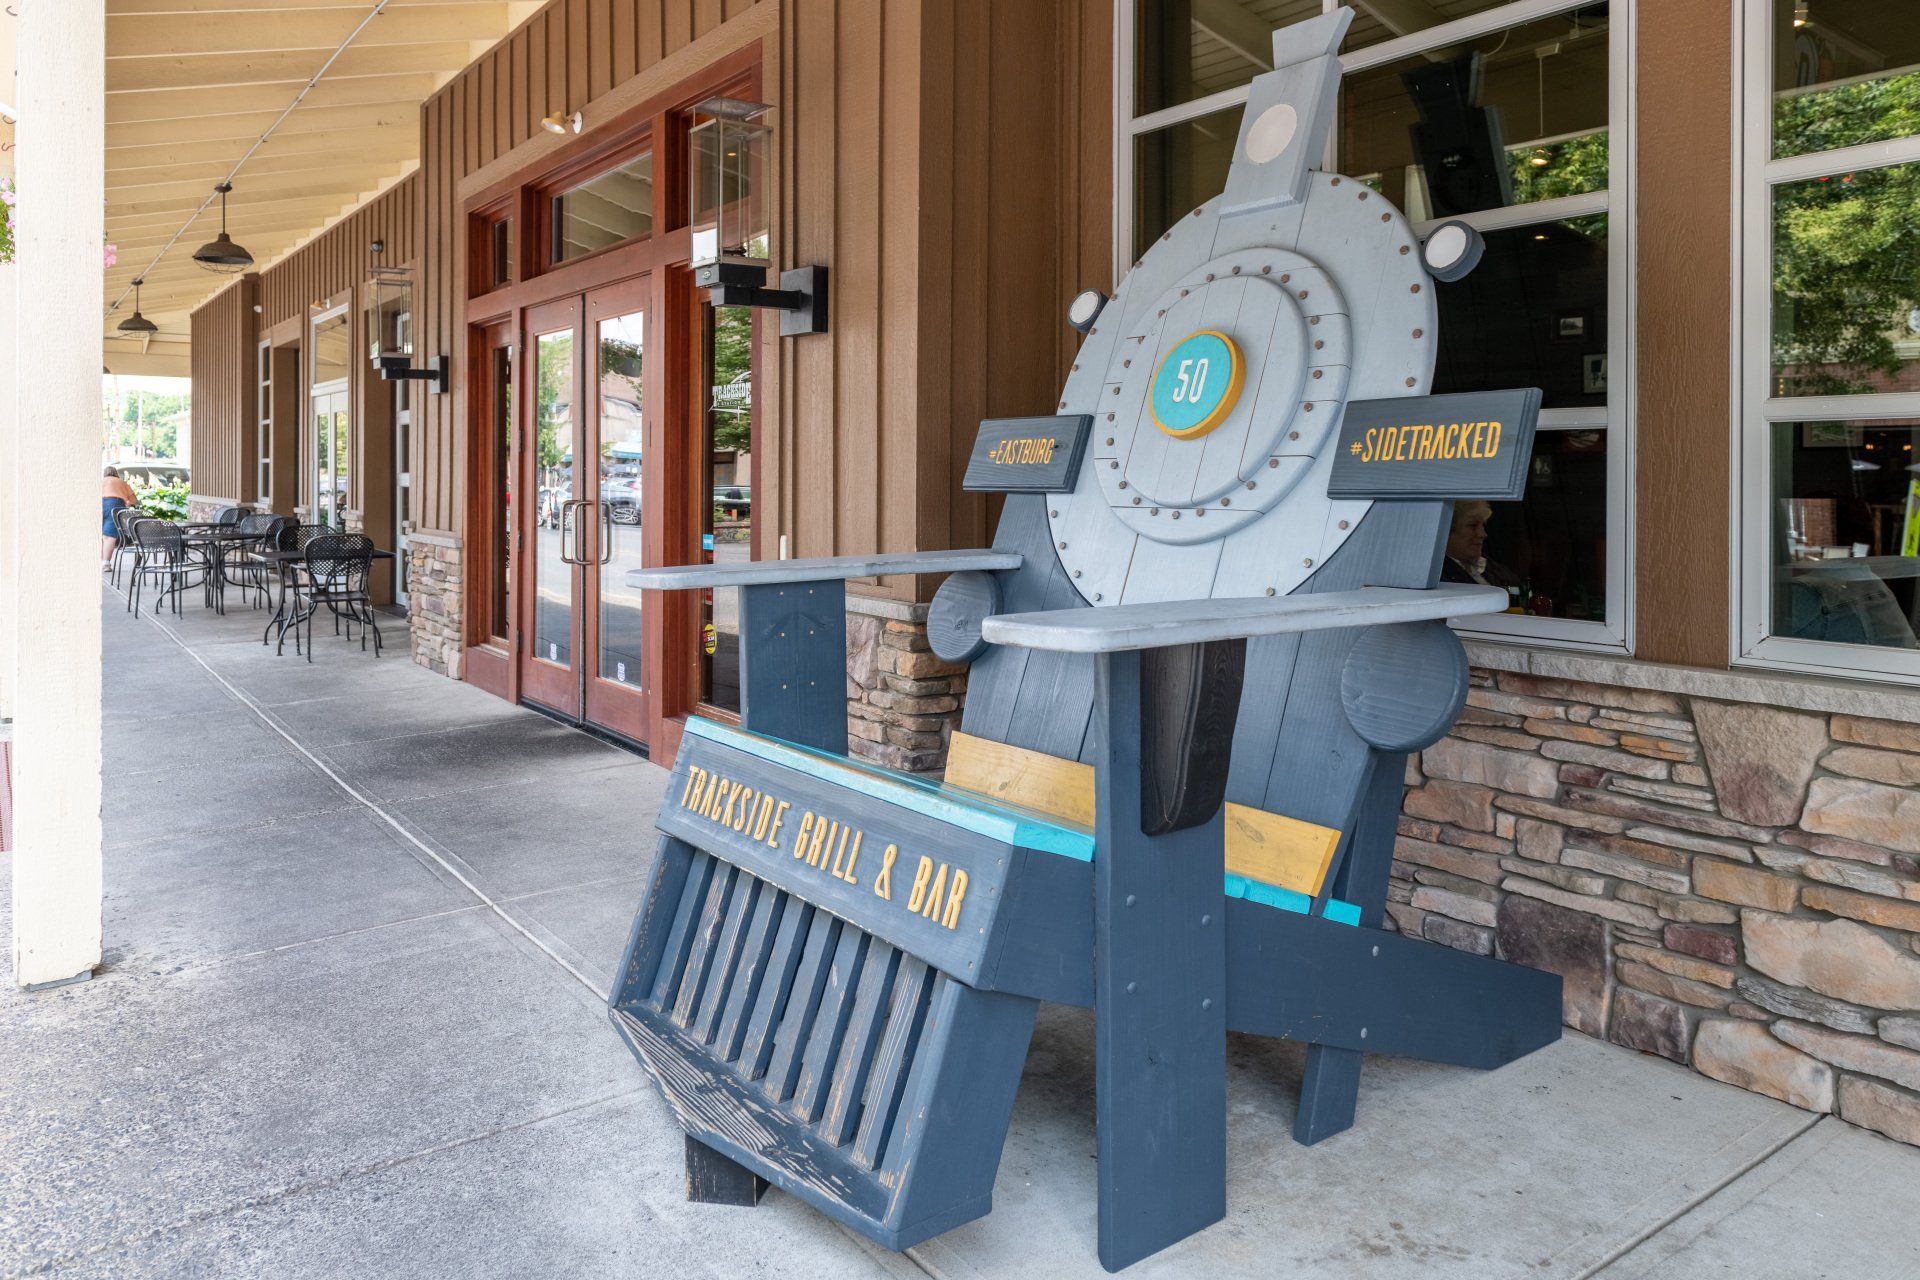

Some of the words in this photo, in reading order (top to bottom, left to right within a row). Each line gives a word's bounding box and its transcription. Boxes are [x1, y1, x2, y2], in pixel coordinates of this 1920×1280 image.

[712, 382, 752, 407] TRACKSIDE
[1172, 357, 1209, 404] 50
[987, 438, 1055, 465] #EASTBURG
[1350, 421, 1502, 463] #SIDETRACKED
[680, 764, 792, 849] TRACKSIDE
[793, 810, 864, 886] GRILL
[873, 843, 898, 901] &
[906, 855, 970, 931] BAR
